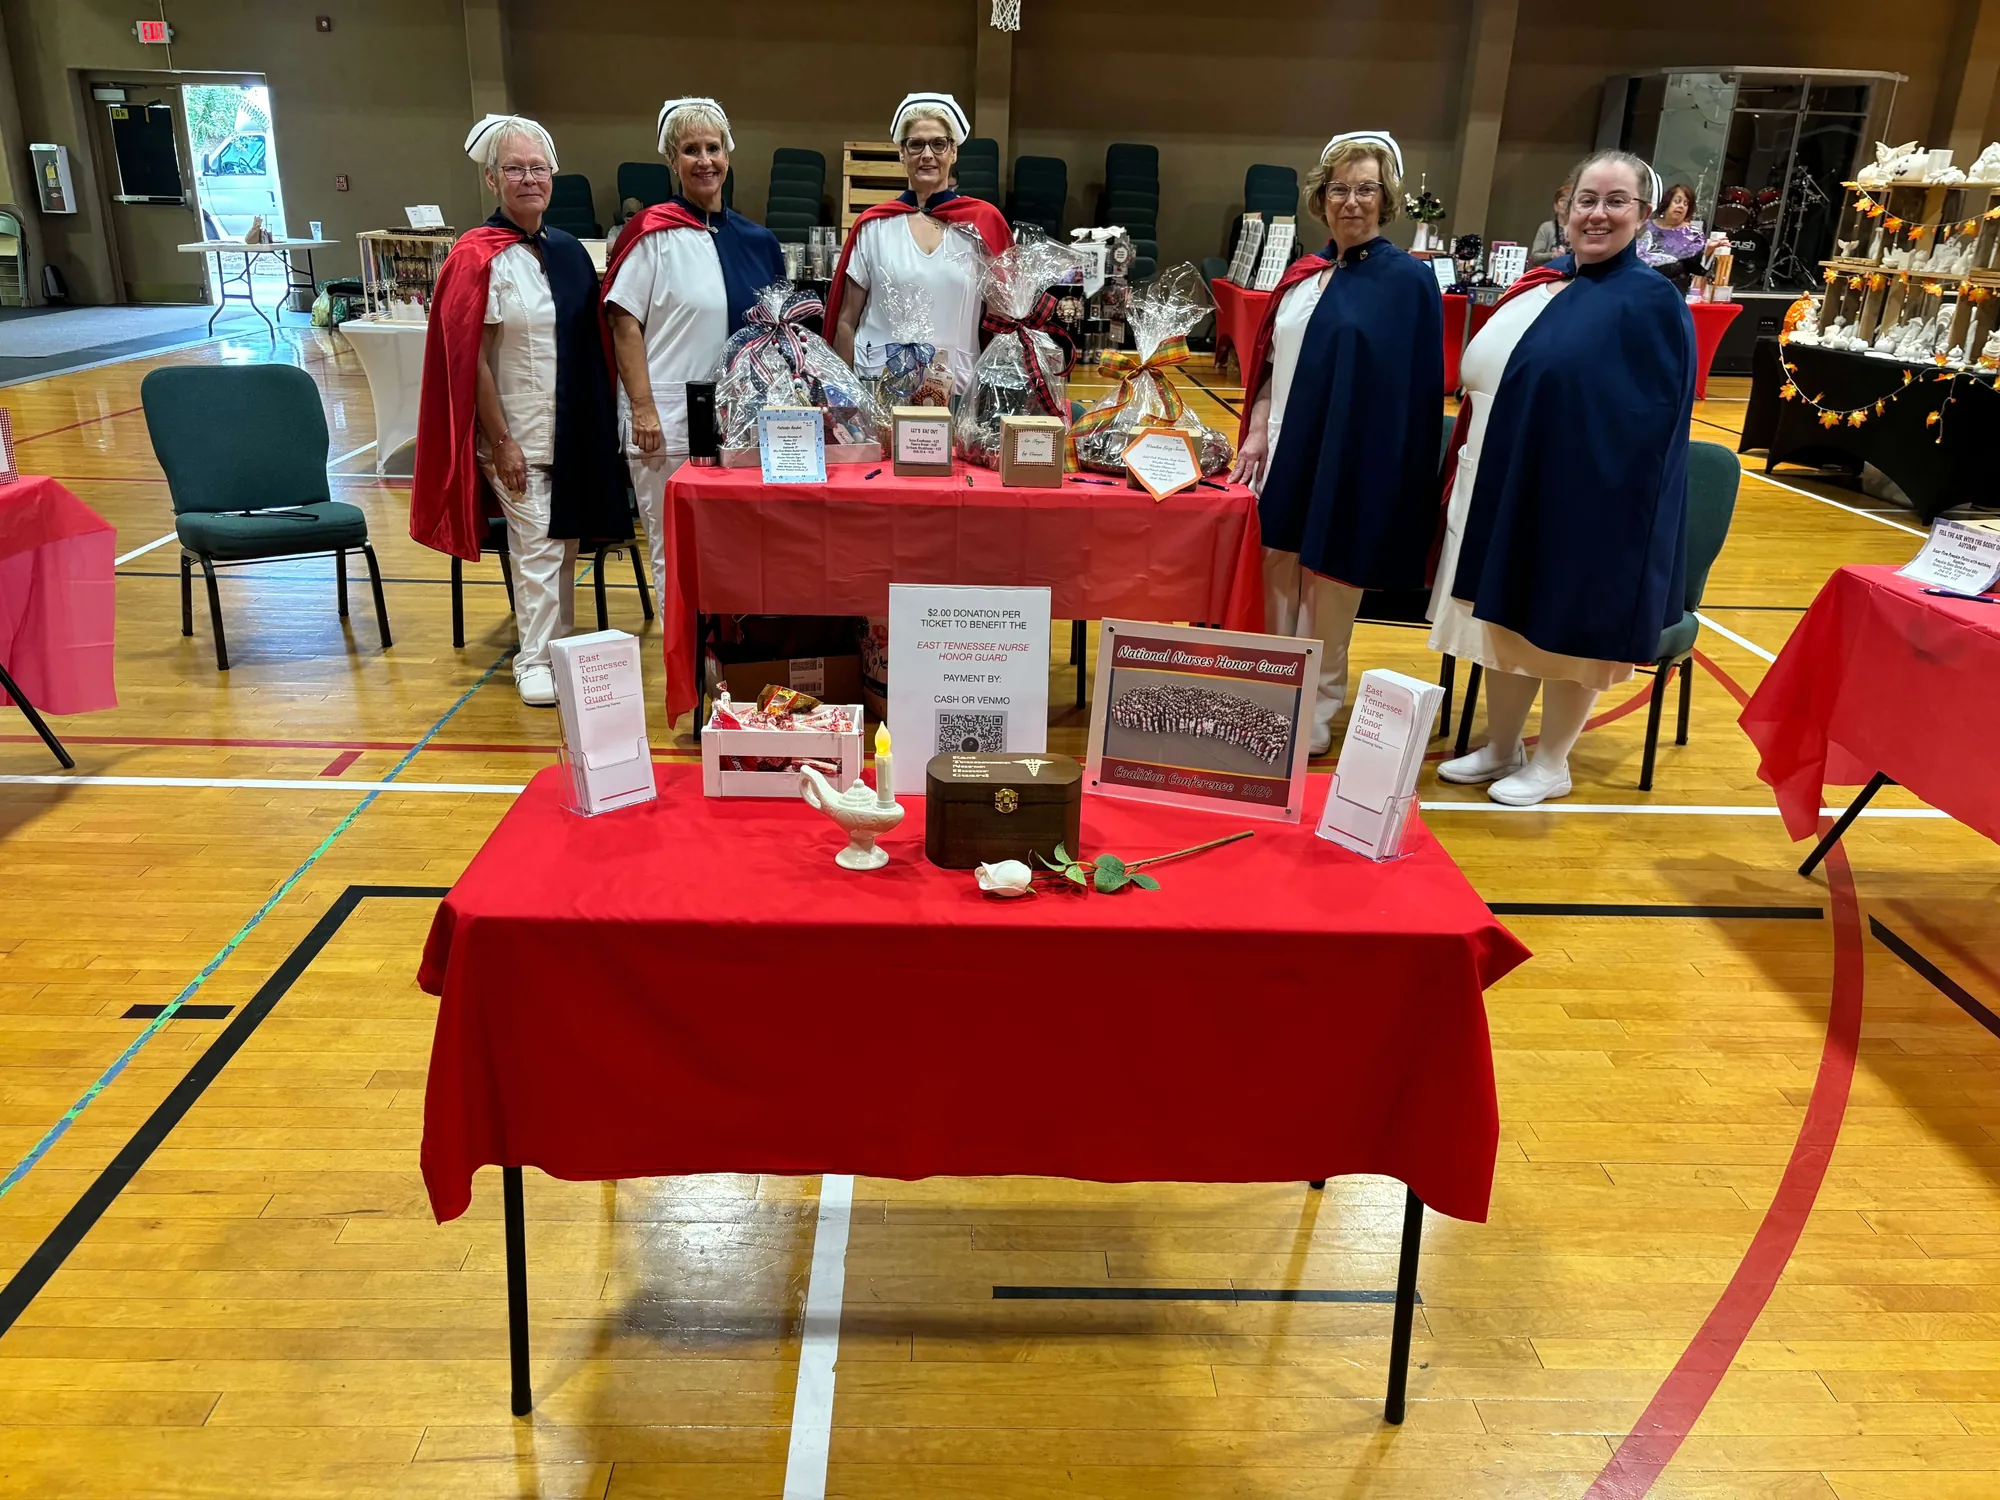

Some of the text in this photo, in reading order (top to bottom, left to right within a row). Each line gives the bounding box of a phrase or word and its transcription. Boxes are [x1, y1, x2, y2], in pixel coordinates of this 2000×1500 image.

[927, 608, 1021, 618] $2.00 DONATION PER
[920, 619, 1027, 630] TICKET TO BENEFIT THE
[917, 641, 1030, 652] EAST TENNESSEE NURSE
[578, 653, 600, 664] East
[938, 652, 1008, 662] HONOR GUARD
[1117, 645, 1298, 677] National Nurses Honor Guard
[580, 660, 628, 674] Tennessee
[581, 673, 609, 684] Nurse
[943, 674, 1002, 683] PAYMENT BY:
[583, 683, 611, 694] Honor
[1365, 684, 1383, 698] East
[584, 691, 613, 705] Guard
[934, 695, 1011, 705] CASH OR VENMO
[1364, 694, 1403, 716] Tennessee
[1360, 704, 1384, 720] Nurse
[1357, 714, 1383, 730] Honor
[1354, 724, 1380, 741] Guard
[1114, 765, 1273, 799] Coalition Conference 2024
